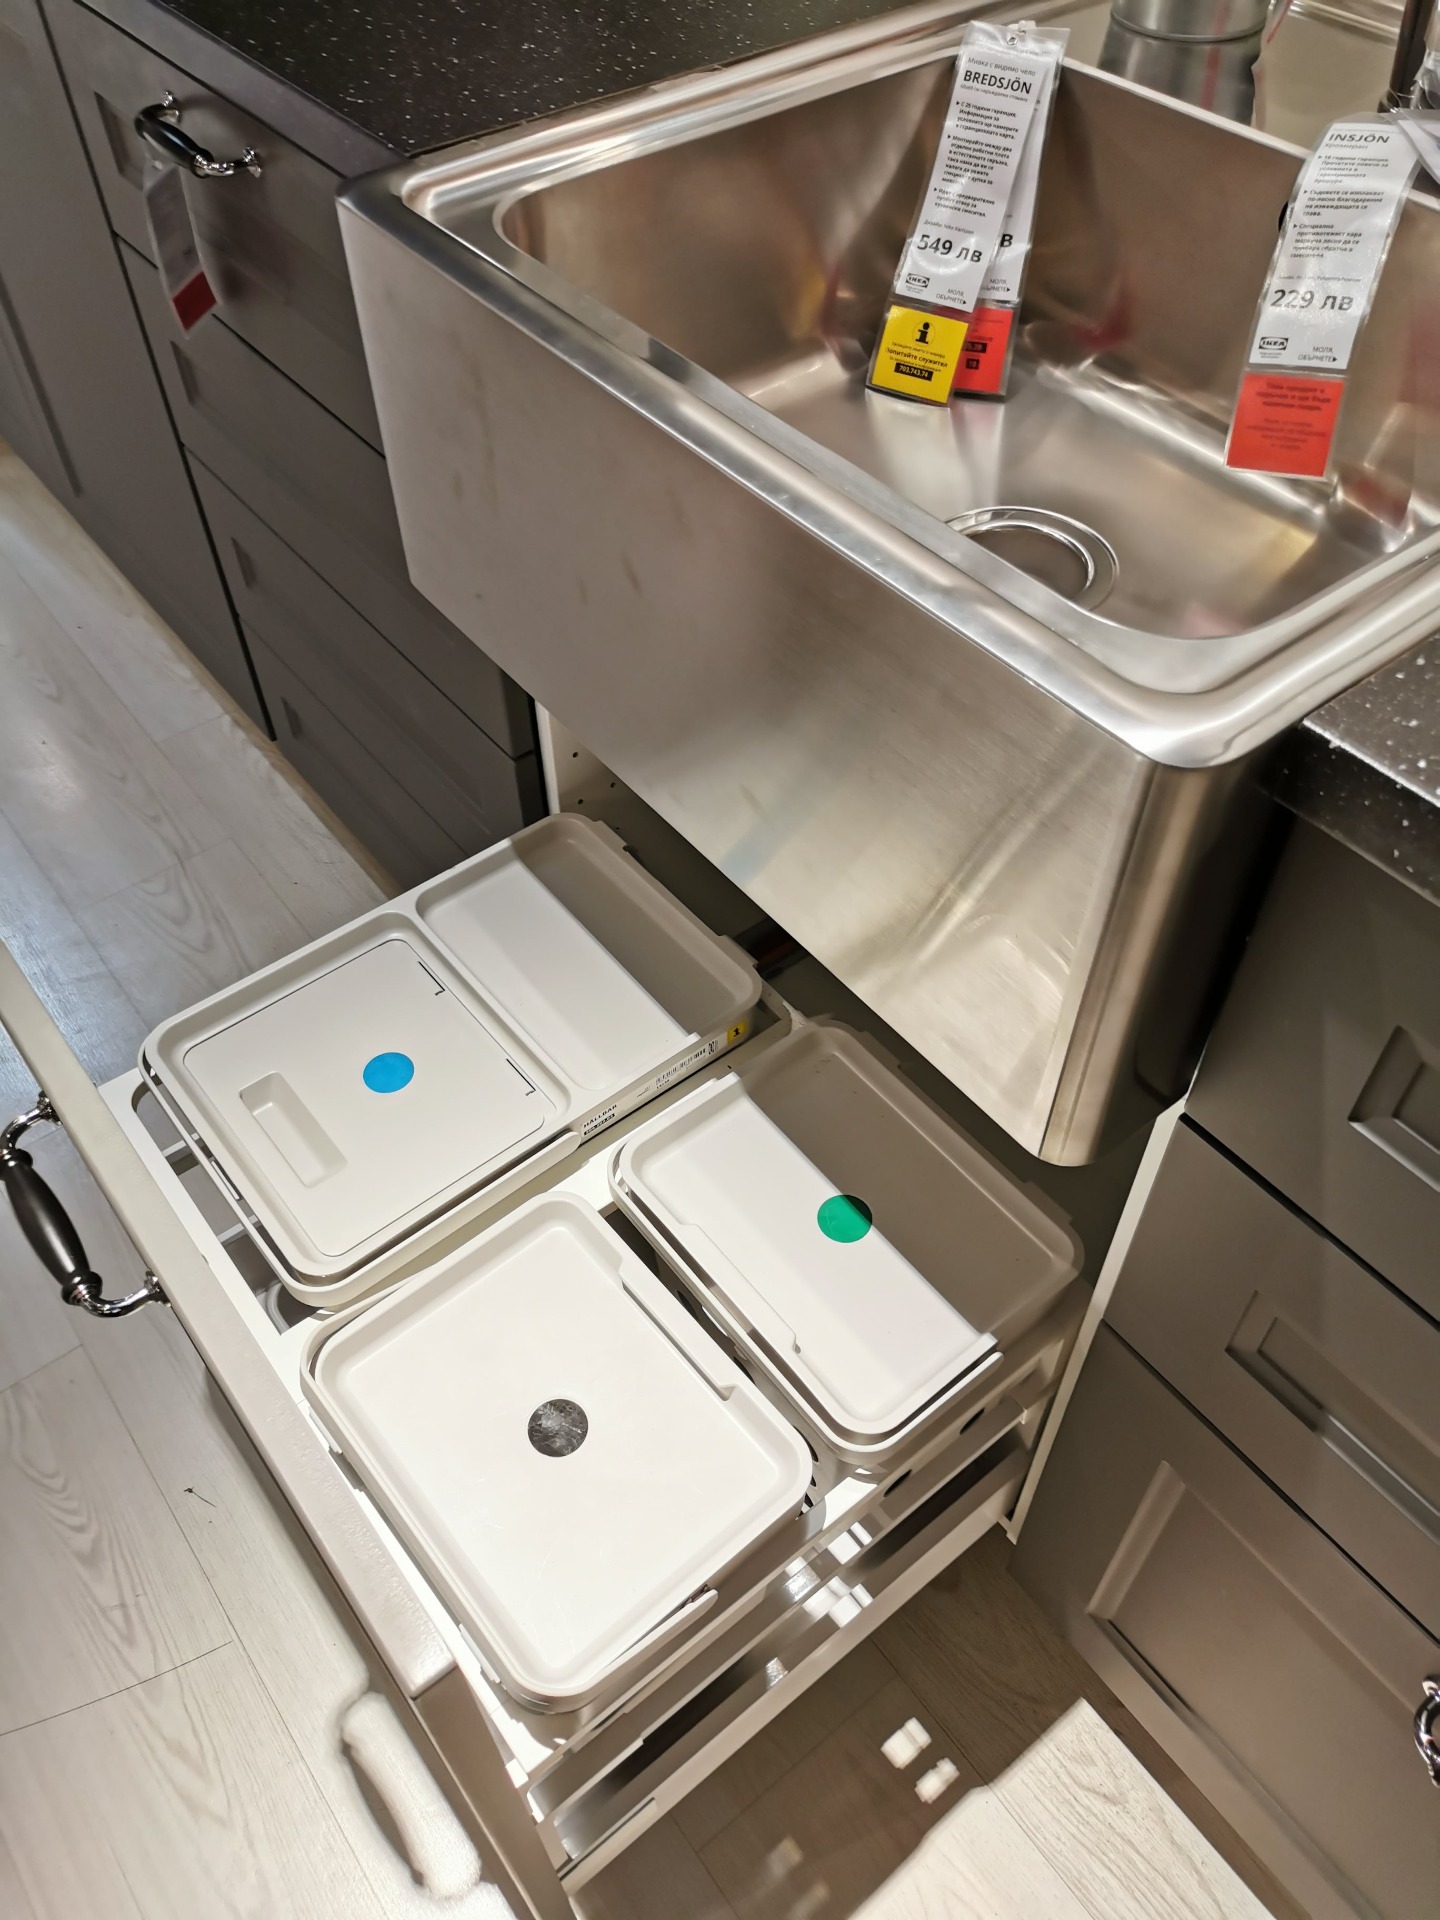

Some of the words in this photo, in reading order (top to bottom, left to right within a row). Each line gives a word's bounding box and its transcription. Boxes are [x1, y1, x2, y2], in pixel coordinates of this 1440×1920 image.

[994, 62, 1019, 73] видимо
[963, 70, 1032, 94] BREDSJÖN
[1328, 133, 1390, 144] INSJÖN
[917, 234, 953, 256] 549
[936, 294, 963, 304] ОБЪРНЕТЕ
[1270, 289, 1315, 309] 229
[918, 355, 948, 368] служител
[1298, 354, 1333, 362] ОБЪРНЕТЕ
